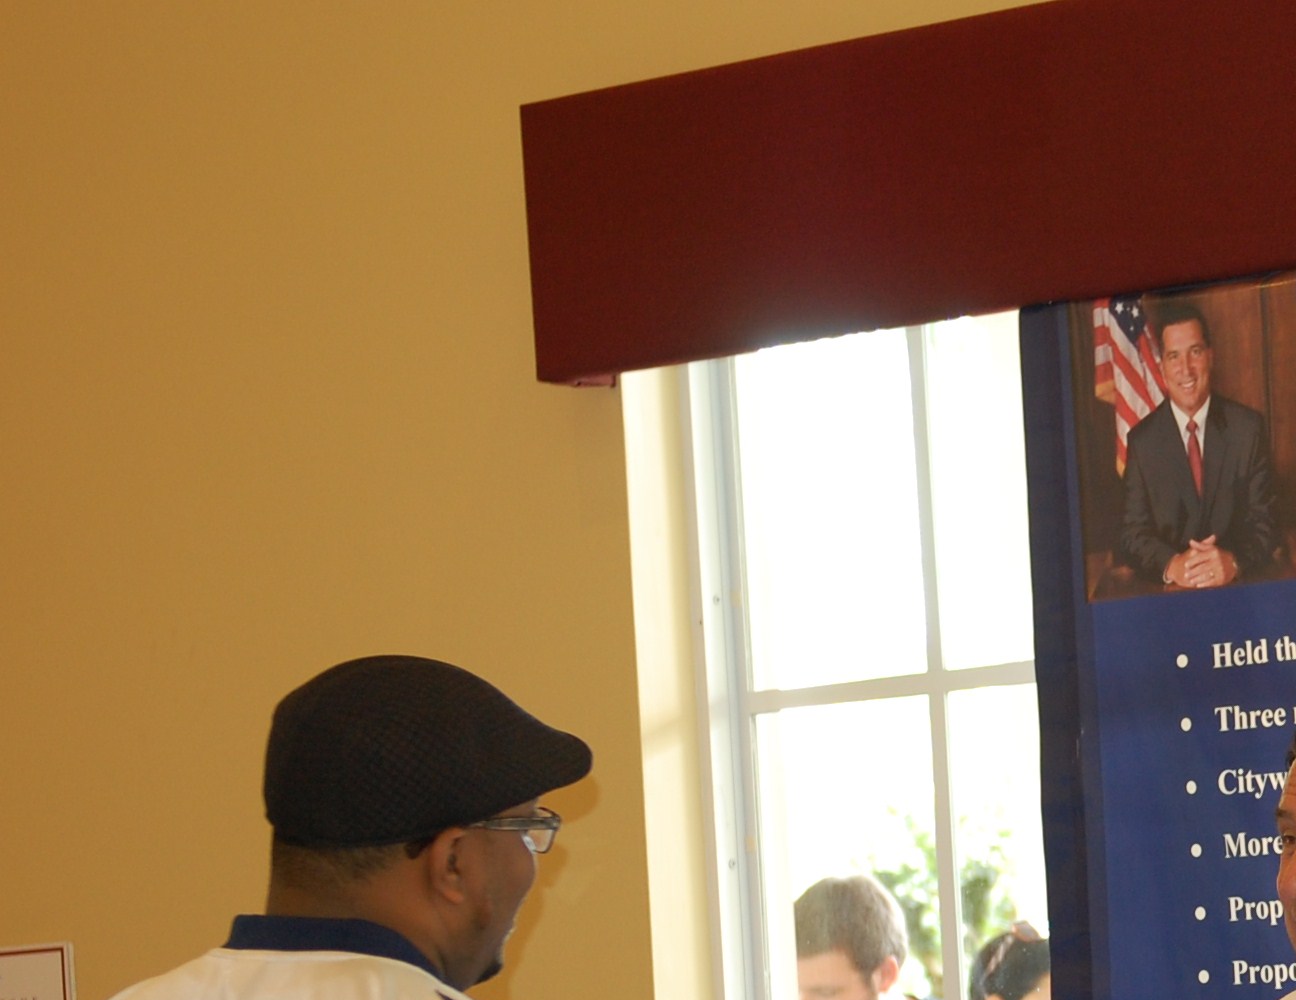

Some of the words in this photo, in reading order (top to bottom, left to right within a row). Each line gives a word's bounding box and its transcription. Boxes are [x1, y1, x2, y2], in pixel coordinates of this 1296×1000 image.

[1213, 637, 1268, 669] Held
[1214, 705, 1286, 733] Three
[1217, 768, 1290, 800] Cityw
[1223, 831, 1284, 859] More
[1227, 895, 1285, 926] Prop
